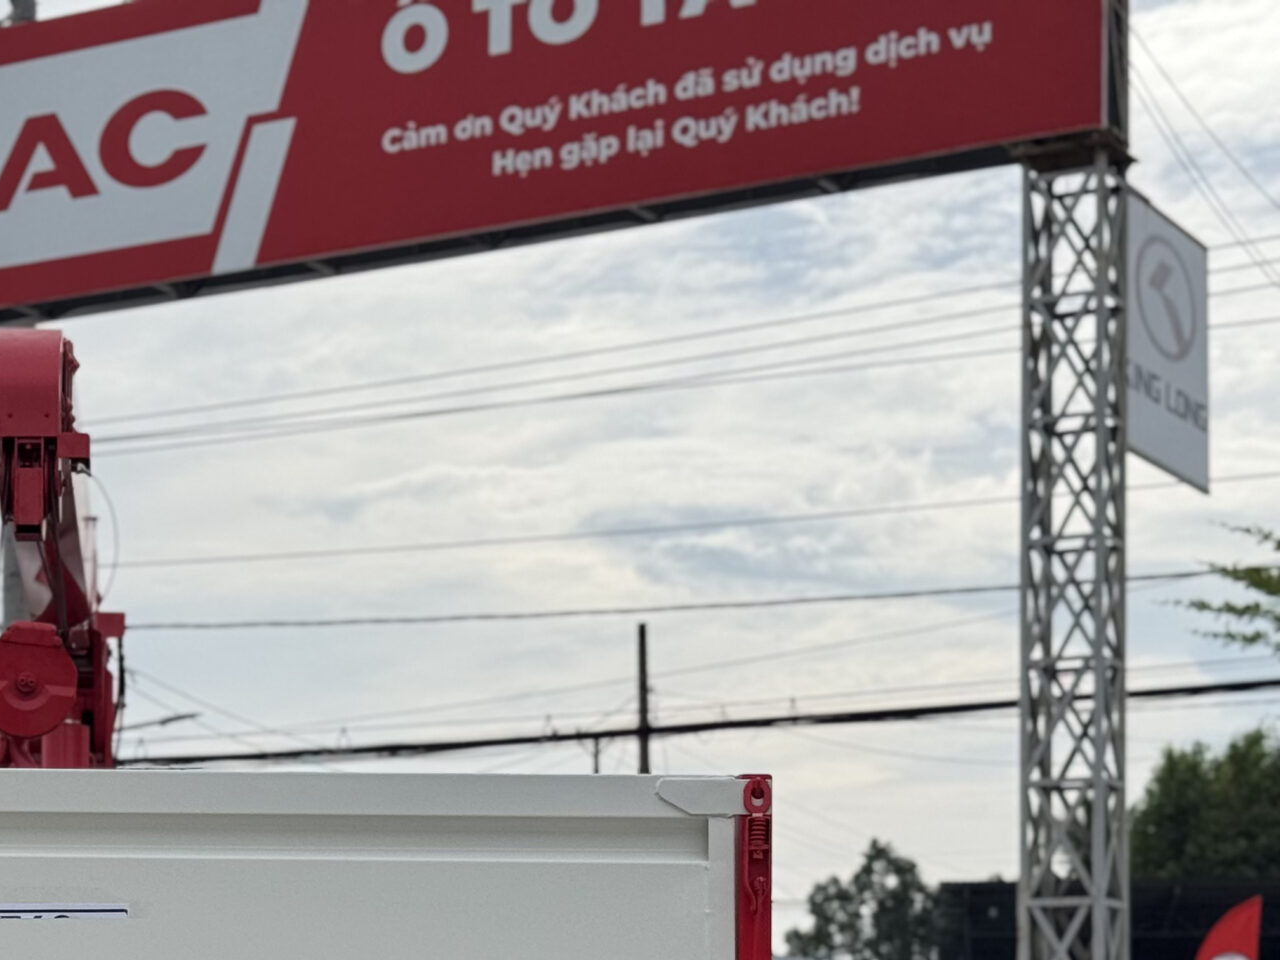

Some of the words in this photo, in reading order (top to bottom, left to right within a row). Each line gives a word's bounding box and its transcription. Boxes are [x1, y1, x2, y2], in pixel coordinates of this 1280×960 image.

[569, 79, 667, 120] Khách
[674, 67, 716, 100] đã
[769, 46, 857, 85] dụng
[865, 27, 940, 68] dịch
[947, 20, 993, 52] vụ
[491, 148, 553, 178] Hẹn
[627, 119, 665, 157] lại
[745, 85, 861, 132] Khách!
